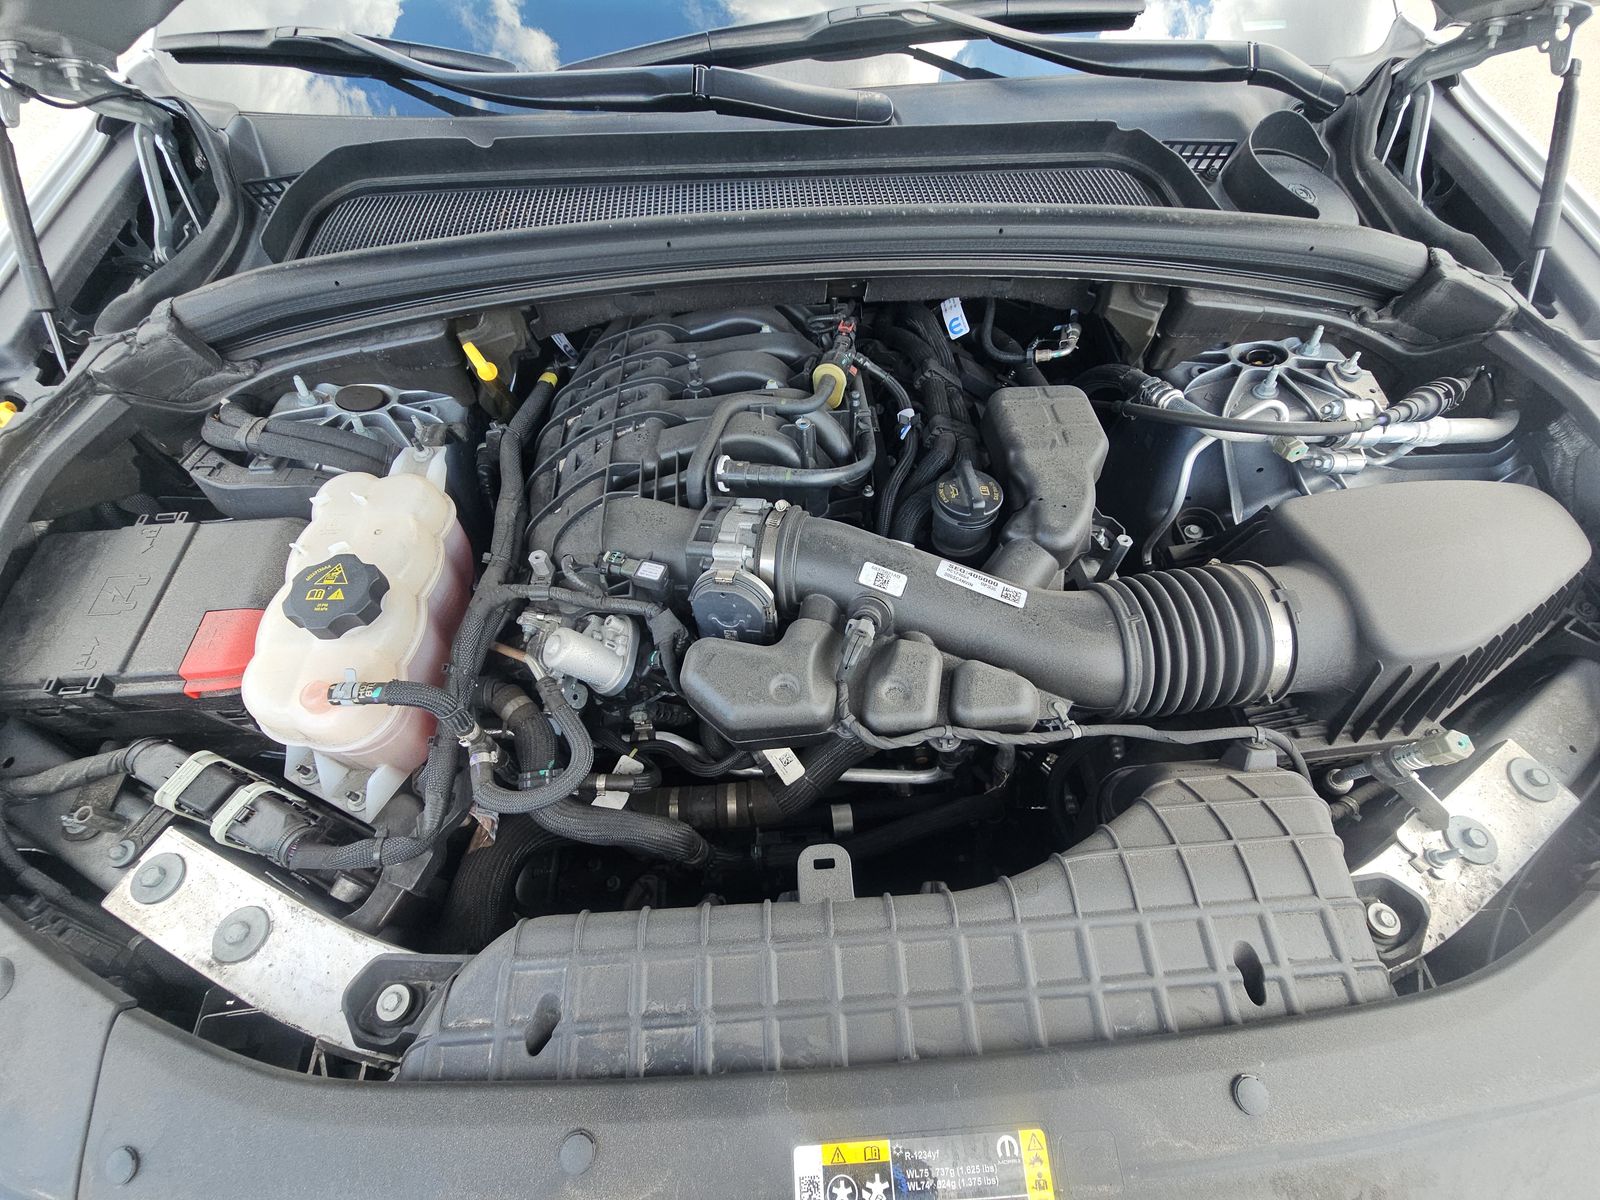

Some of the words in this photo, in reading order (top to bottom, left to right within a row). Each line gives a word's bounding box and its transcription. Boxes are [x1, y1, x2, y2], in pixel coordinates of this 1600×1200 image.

[904, 1149, 939, 1161] R-1234yf
[906, 1168, 929, 1179] WL75
[935, 1167, 955, 1178] 737g
[982, 1164, 998, 1174] lbs)
[907, 1180, 930, 1192] WL74
[984, 1176, 999, 1187] lbs)
